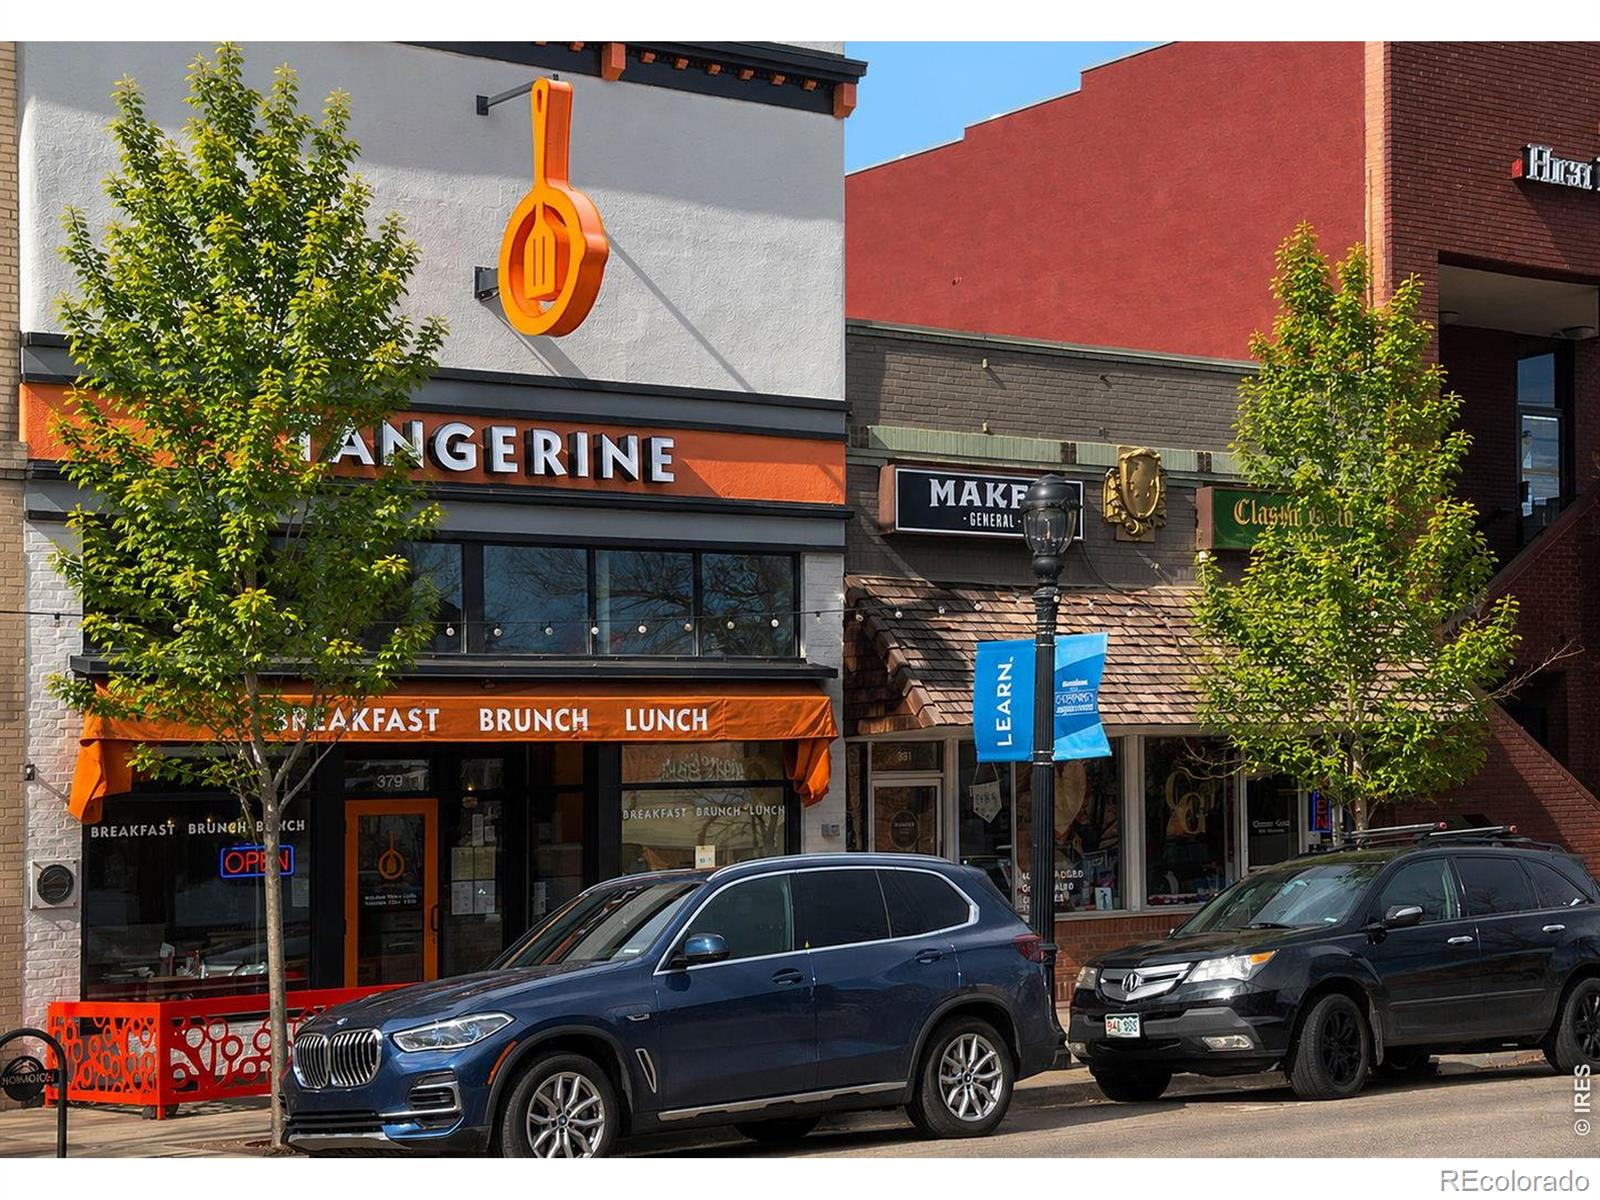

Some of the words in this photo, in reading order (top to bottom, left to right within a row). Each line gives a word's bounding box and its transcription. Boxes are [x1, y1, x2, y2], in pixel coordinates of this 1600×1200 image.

[969, 511, 1015, 528] GENERAL
[995, 656, 1015, 747] LEARN.
[479, 707, 590, 733] BRUNCH
[625, 707, 709, 732] LUNCH
[376, 775, 403, 788] 379
[622, 807, 687, 820] BREAKFAST
[696, 806, 741, 817] BRUNCH
[749, 805, 785, 817] LUNCH
[90, 823, 175, 838] BREAKFAST
[188, 819, 247, 835] BRUNCH
[224, 849, 289, 874] OPEN
